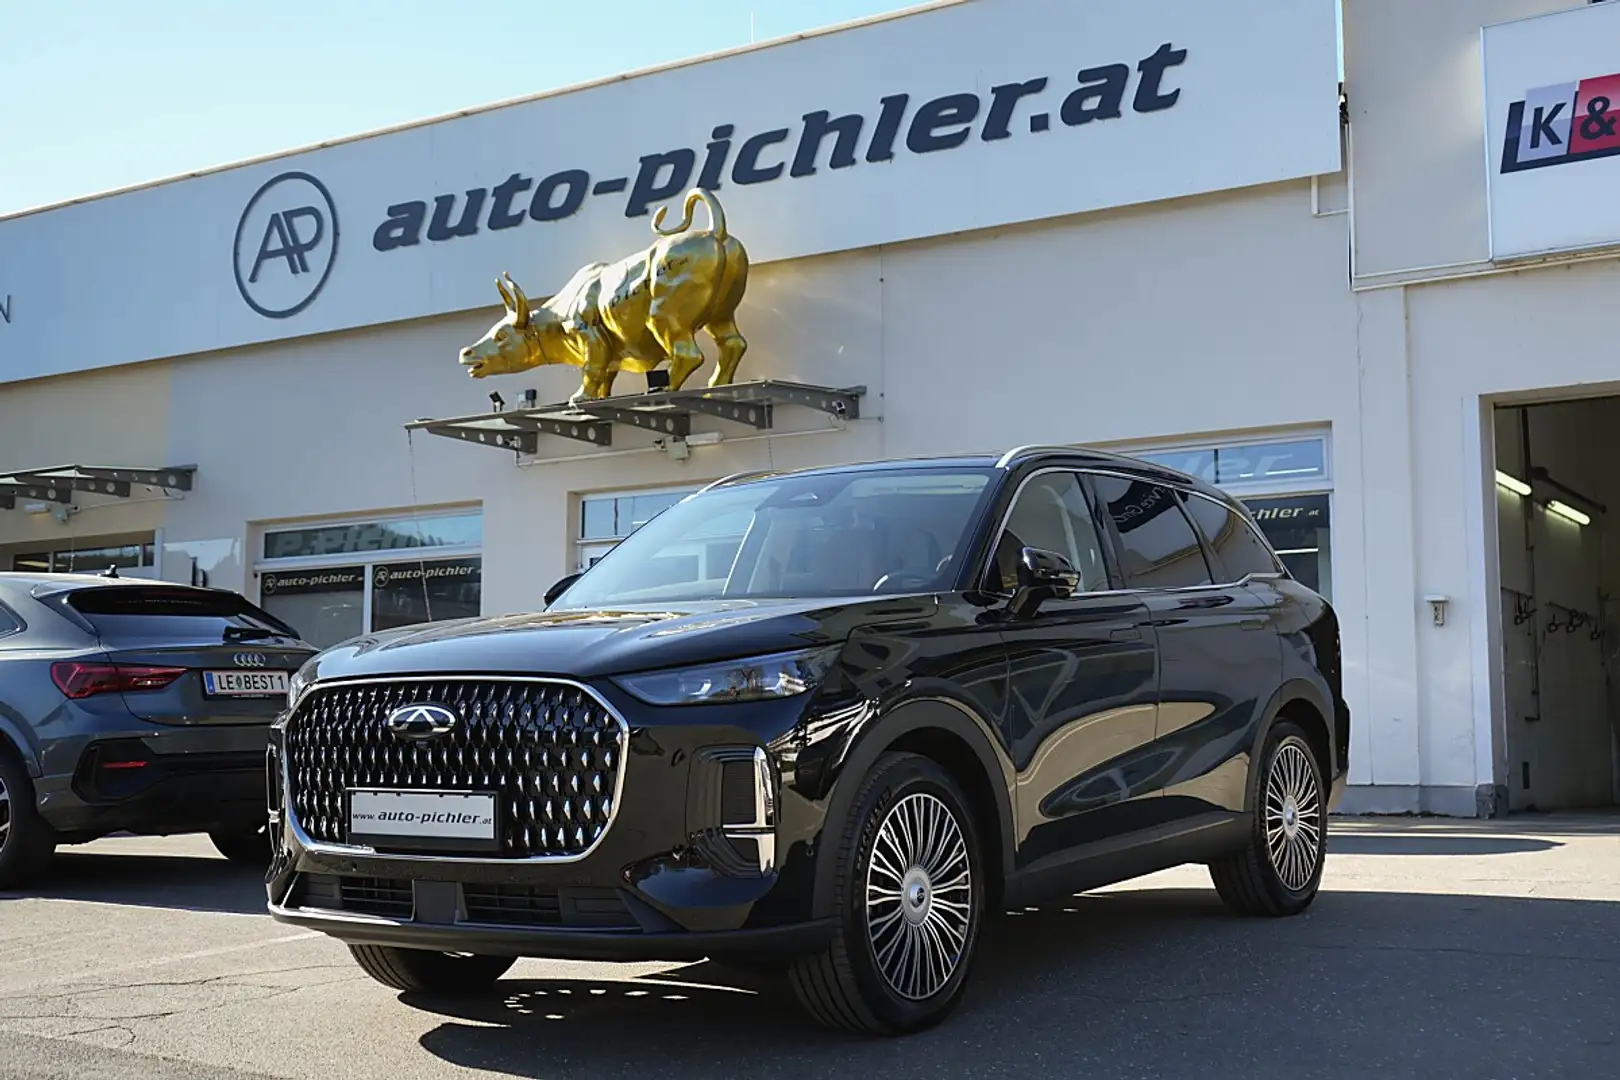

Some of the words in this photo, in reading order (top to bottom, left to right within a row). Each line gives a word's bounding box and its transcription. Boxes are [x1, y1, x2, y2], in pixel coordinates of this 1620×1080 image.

[373, 42, 1187, 252] auto-pichler.at
[217, 675, 234, 690] LE
[243, 675, 275, 690] BEST
[352, 811, 492, 825] www.auto-pichler.at
